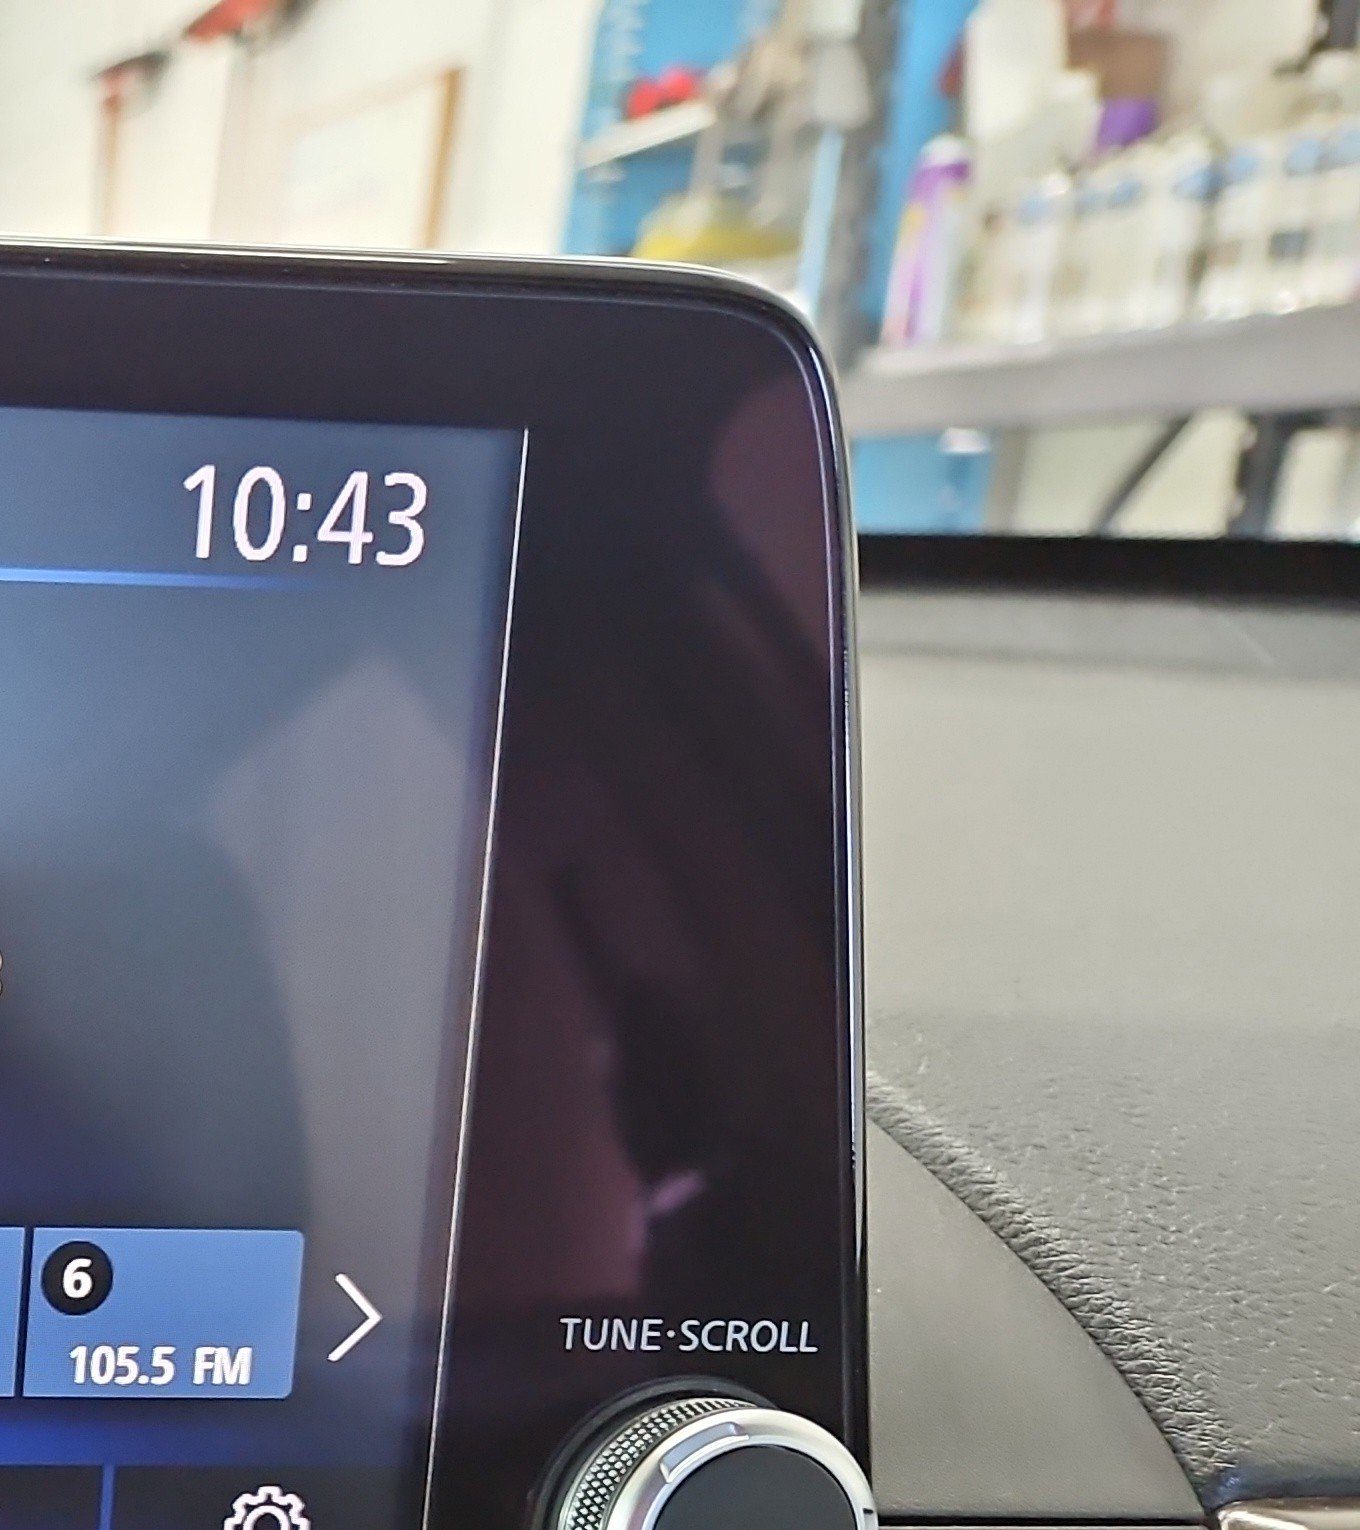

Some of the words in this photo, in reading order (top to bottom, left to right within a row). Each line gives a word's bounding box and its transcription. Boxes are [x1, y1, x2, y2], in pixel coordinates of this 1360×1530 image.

[183, 464, 427, 566] 10:43
[62, 1258, 93, 1299] 6
[68, 1345, 177, 1385] 105.5
[192, 1346, 253, 1385] FM
